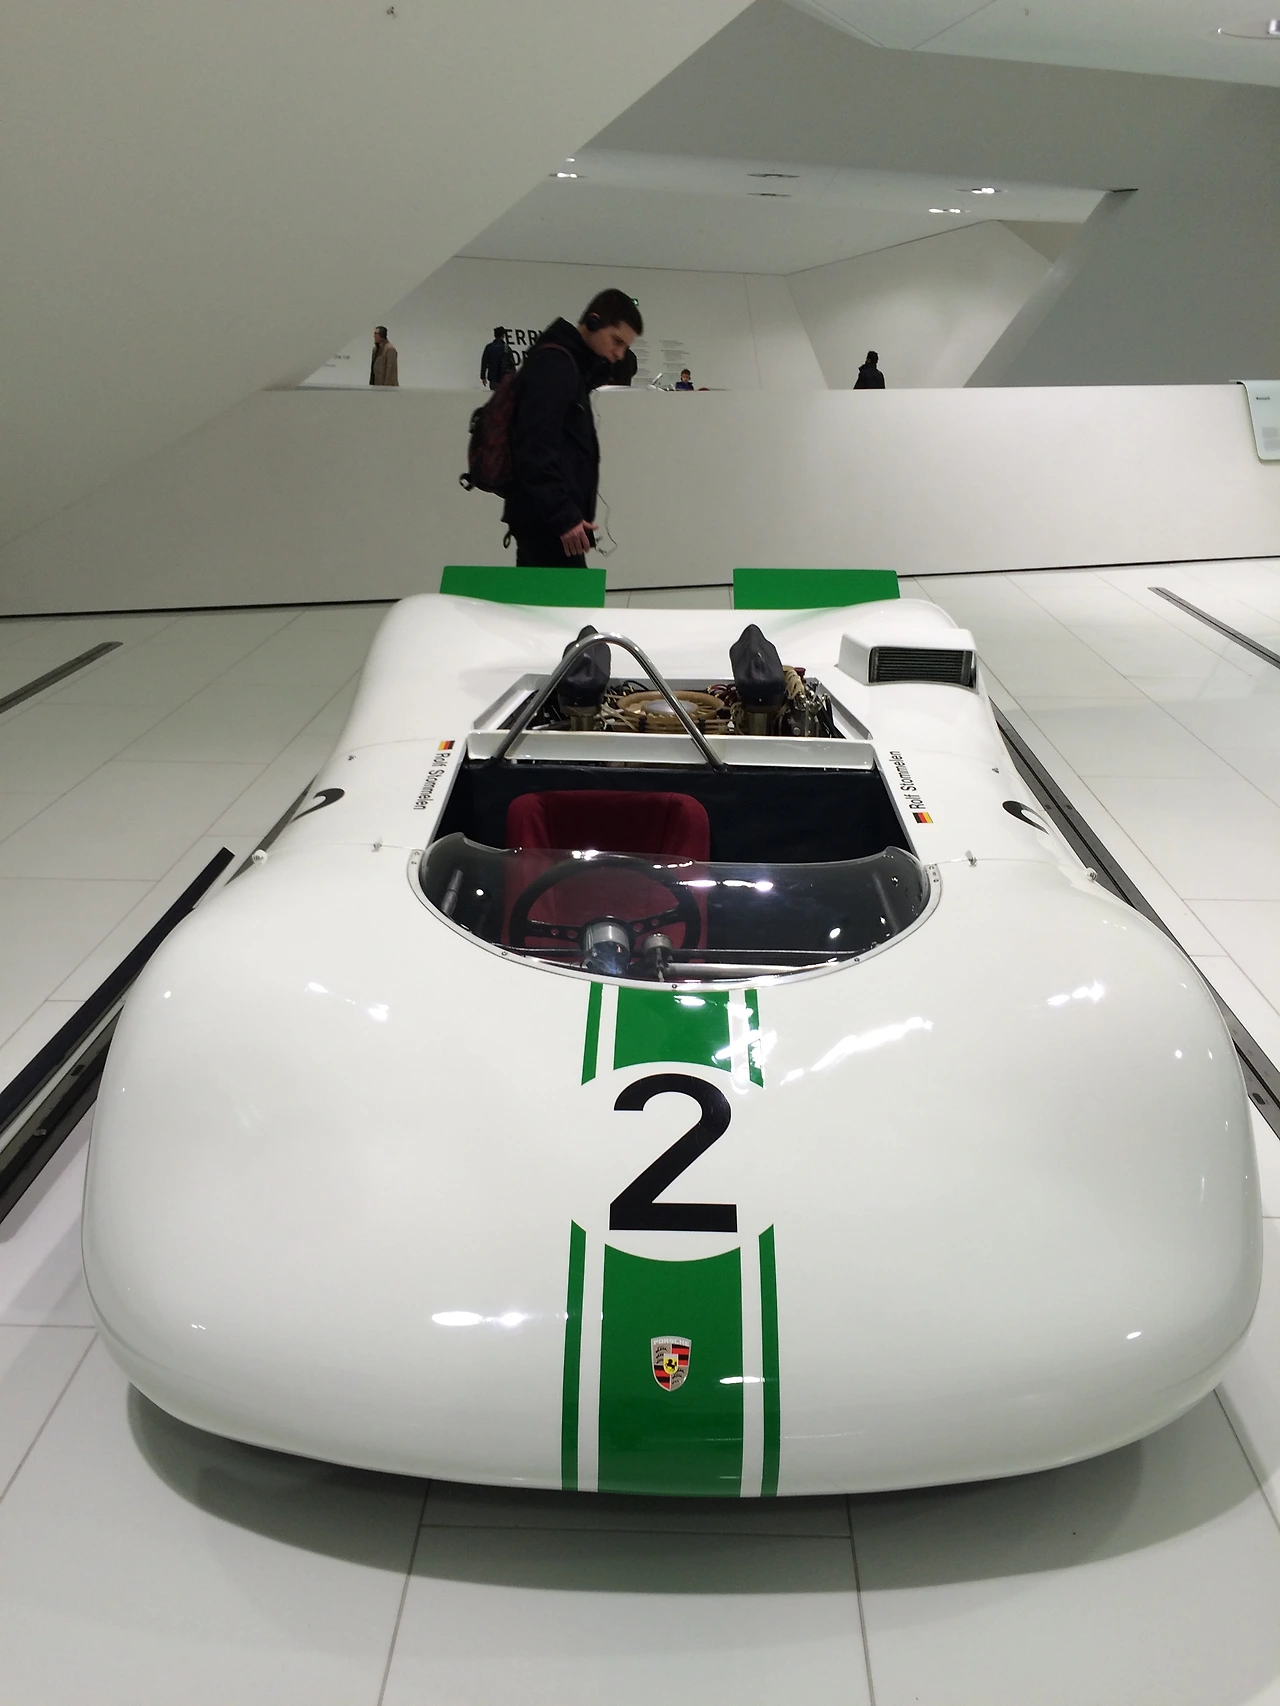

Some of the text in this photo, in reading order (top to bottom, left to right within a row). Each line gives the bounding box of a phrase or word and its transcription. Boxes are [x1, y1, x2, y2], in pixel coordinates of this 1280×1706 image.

[413, 752, 451, 810] Rolf Stommelen
[889, 751, 926, 809] Rolf Stommelen
[609, 1073, 738, 1233] 2
